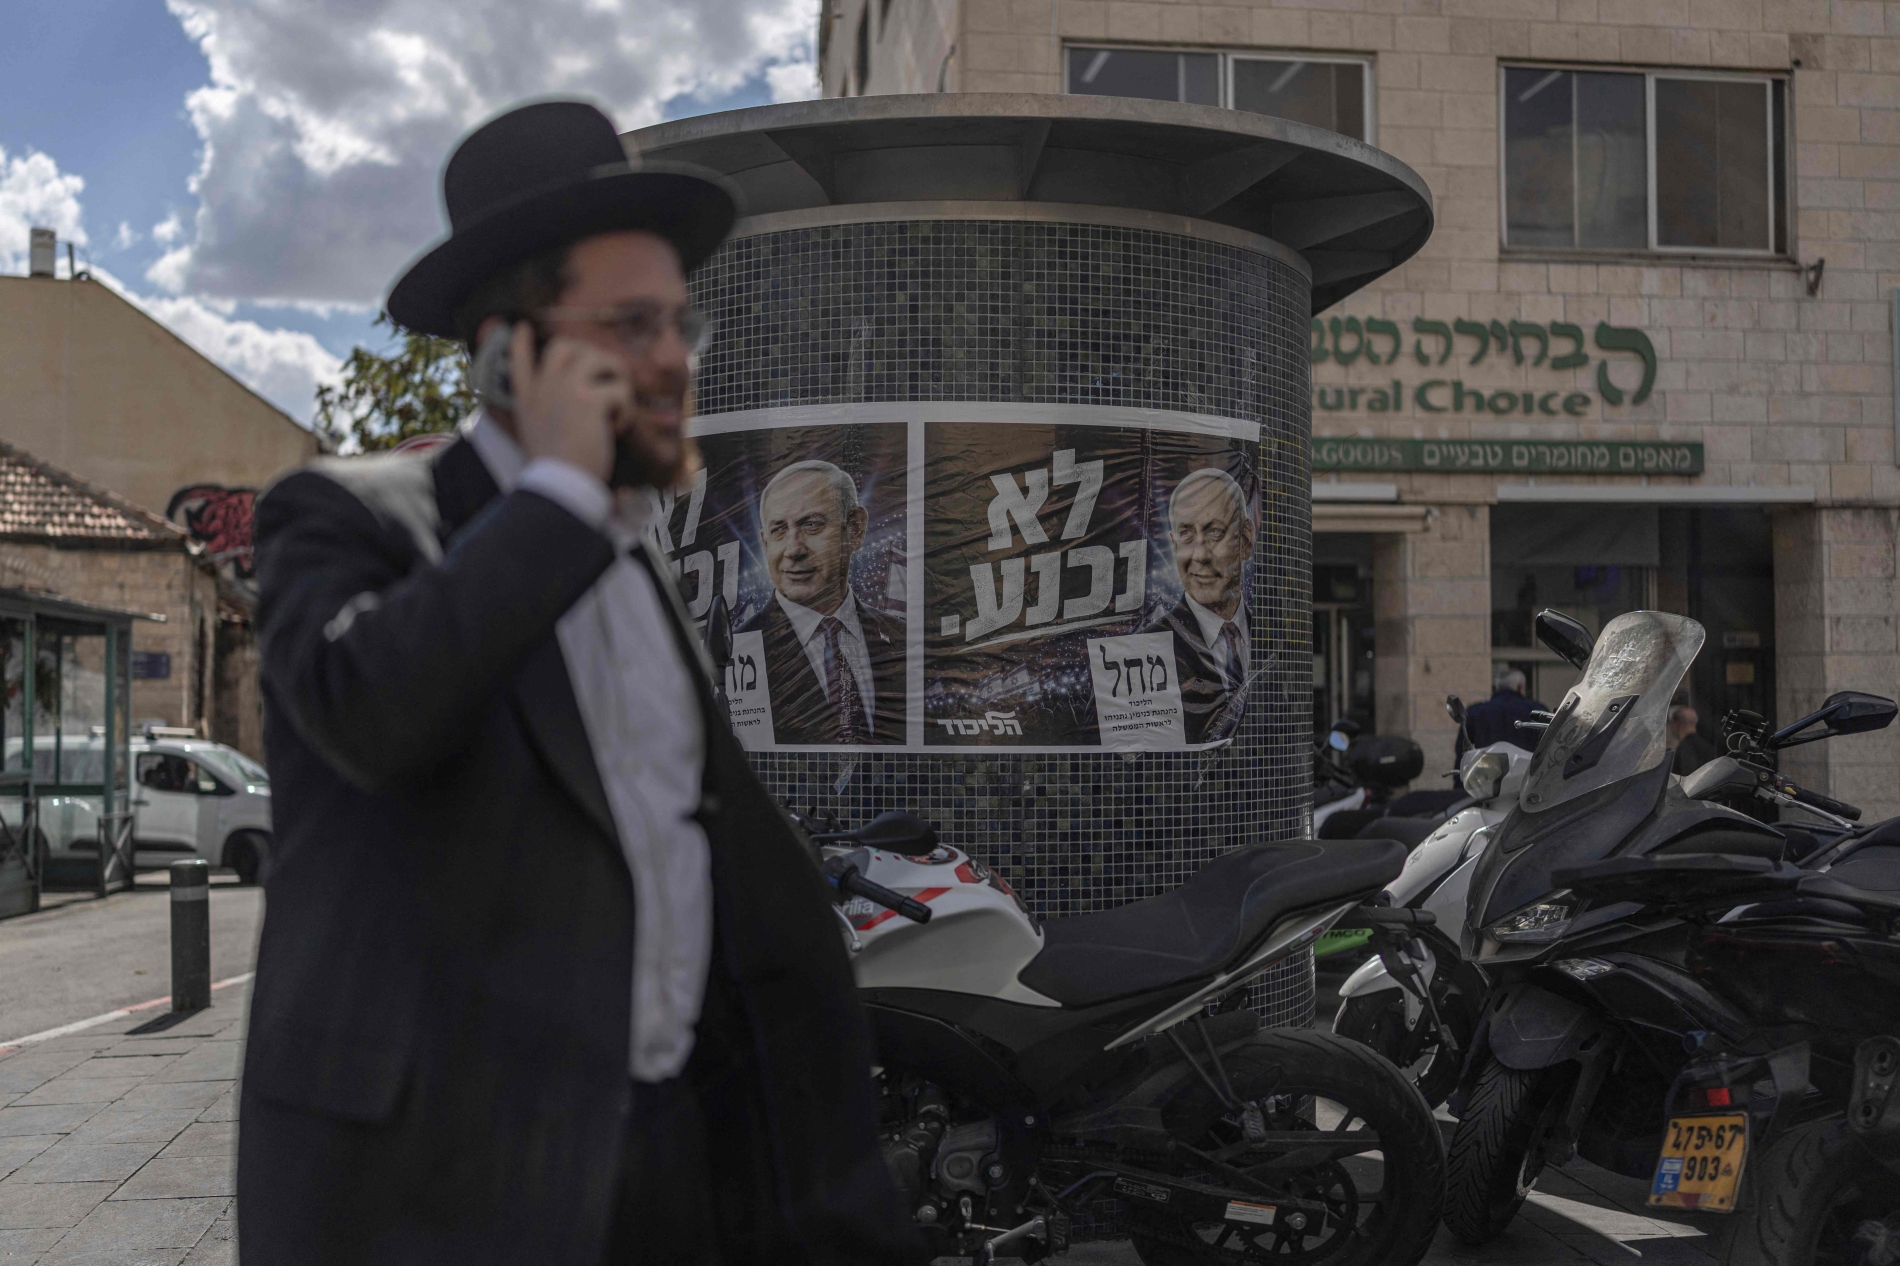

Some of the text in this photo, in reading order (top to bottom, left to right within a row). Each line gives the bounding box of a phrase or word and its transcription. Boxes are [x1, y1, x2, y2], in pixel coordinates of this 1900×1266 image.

[1311, 380, 1591, 415] ural Choice
[1423, 443, 1691, 468] מאפים מחומרים טבעיים
[987, 448, 1104, 551] לא
[941, 538, 1147, 643] נכנע.
[1099, 644, 1167, 698] מחל
[1104, 708, 1178, 722] בהנהגת בנימין נתניהו
[1129, 699, 1153, 707] הליכוד
[937, 711, 1023, 736] הליכוד
[1112, 719, 1172, 732] לראשות הממשלה
[1684, 1156, 1721, 1182] 903
